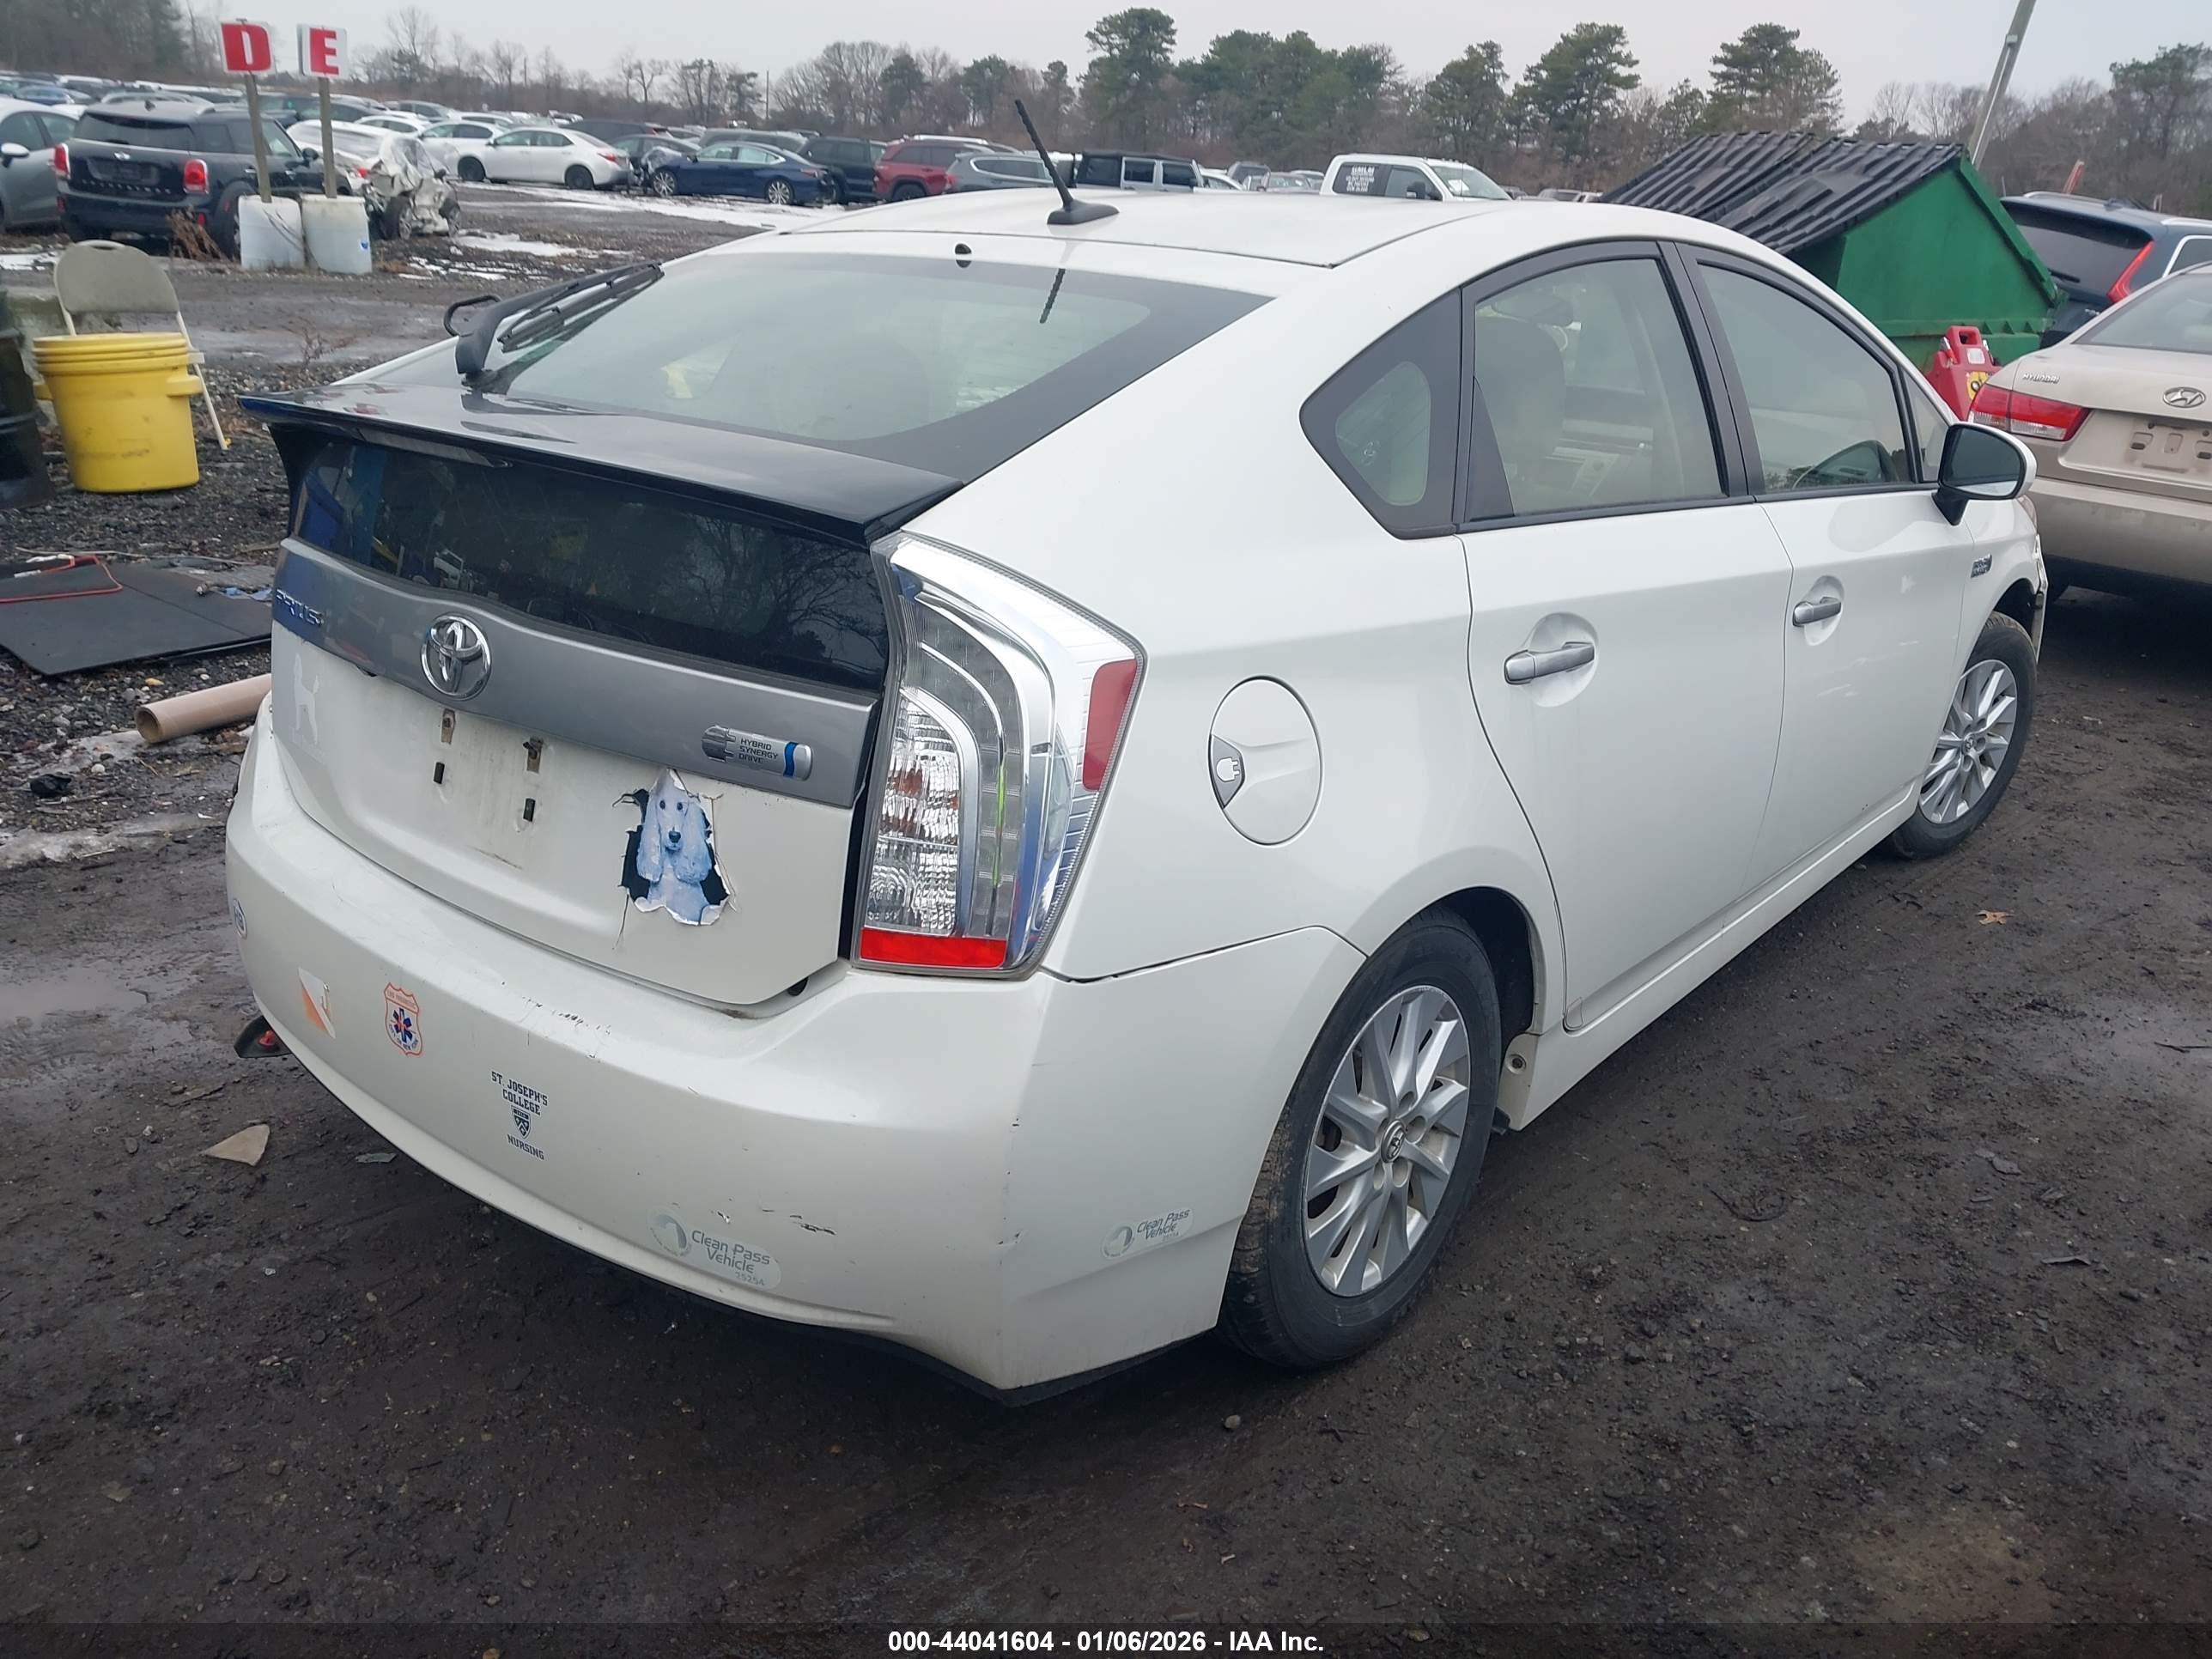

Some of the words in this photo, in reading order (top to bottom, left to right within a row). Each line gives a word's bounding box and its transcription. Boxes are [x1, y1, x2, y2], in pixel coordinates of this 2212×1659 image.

[221, 23, 272, 71] D
[310, 27, 339, 75] E
[2023, 373, 2061, 385] HYUNDAI
[739, 745, 779, 759] SYNERGY
[740, 738, 772, 750] HYBRID
[738, 753, 764, 764] DRIVE
[491, 1071, 505, 1086] ST.
[507, 1079, 548, 1106] JOSEPH'S
[502, 1089, 541, 1116] COLLEGE
[507, 1133, 544, 1160] NURSING
[1137, 1218, 1164, 1233] Clean
[1167, 1209, 1191, 1222] Pass
[1146, 1223, 1178, 1240] Vehicle
[692, 1230, 729, 1253] Clean
[732, 1243, 770, 1265] Pass
[707, 1248, 755, 1273] Vehicle
